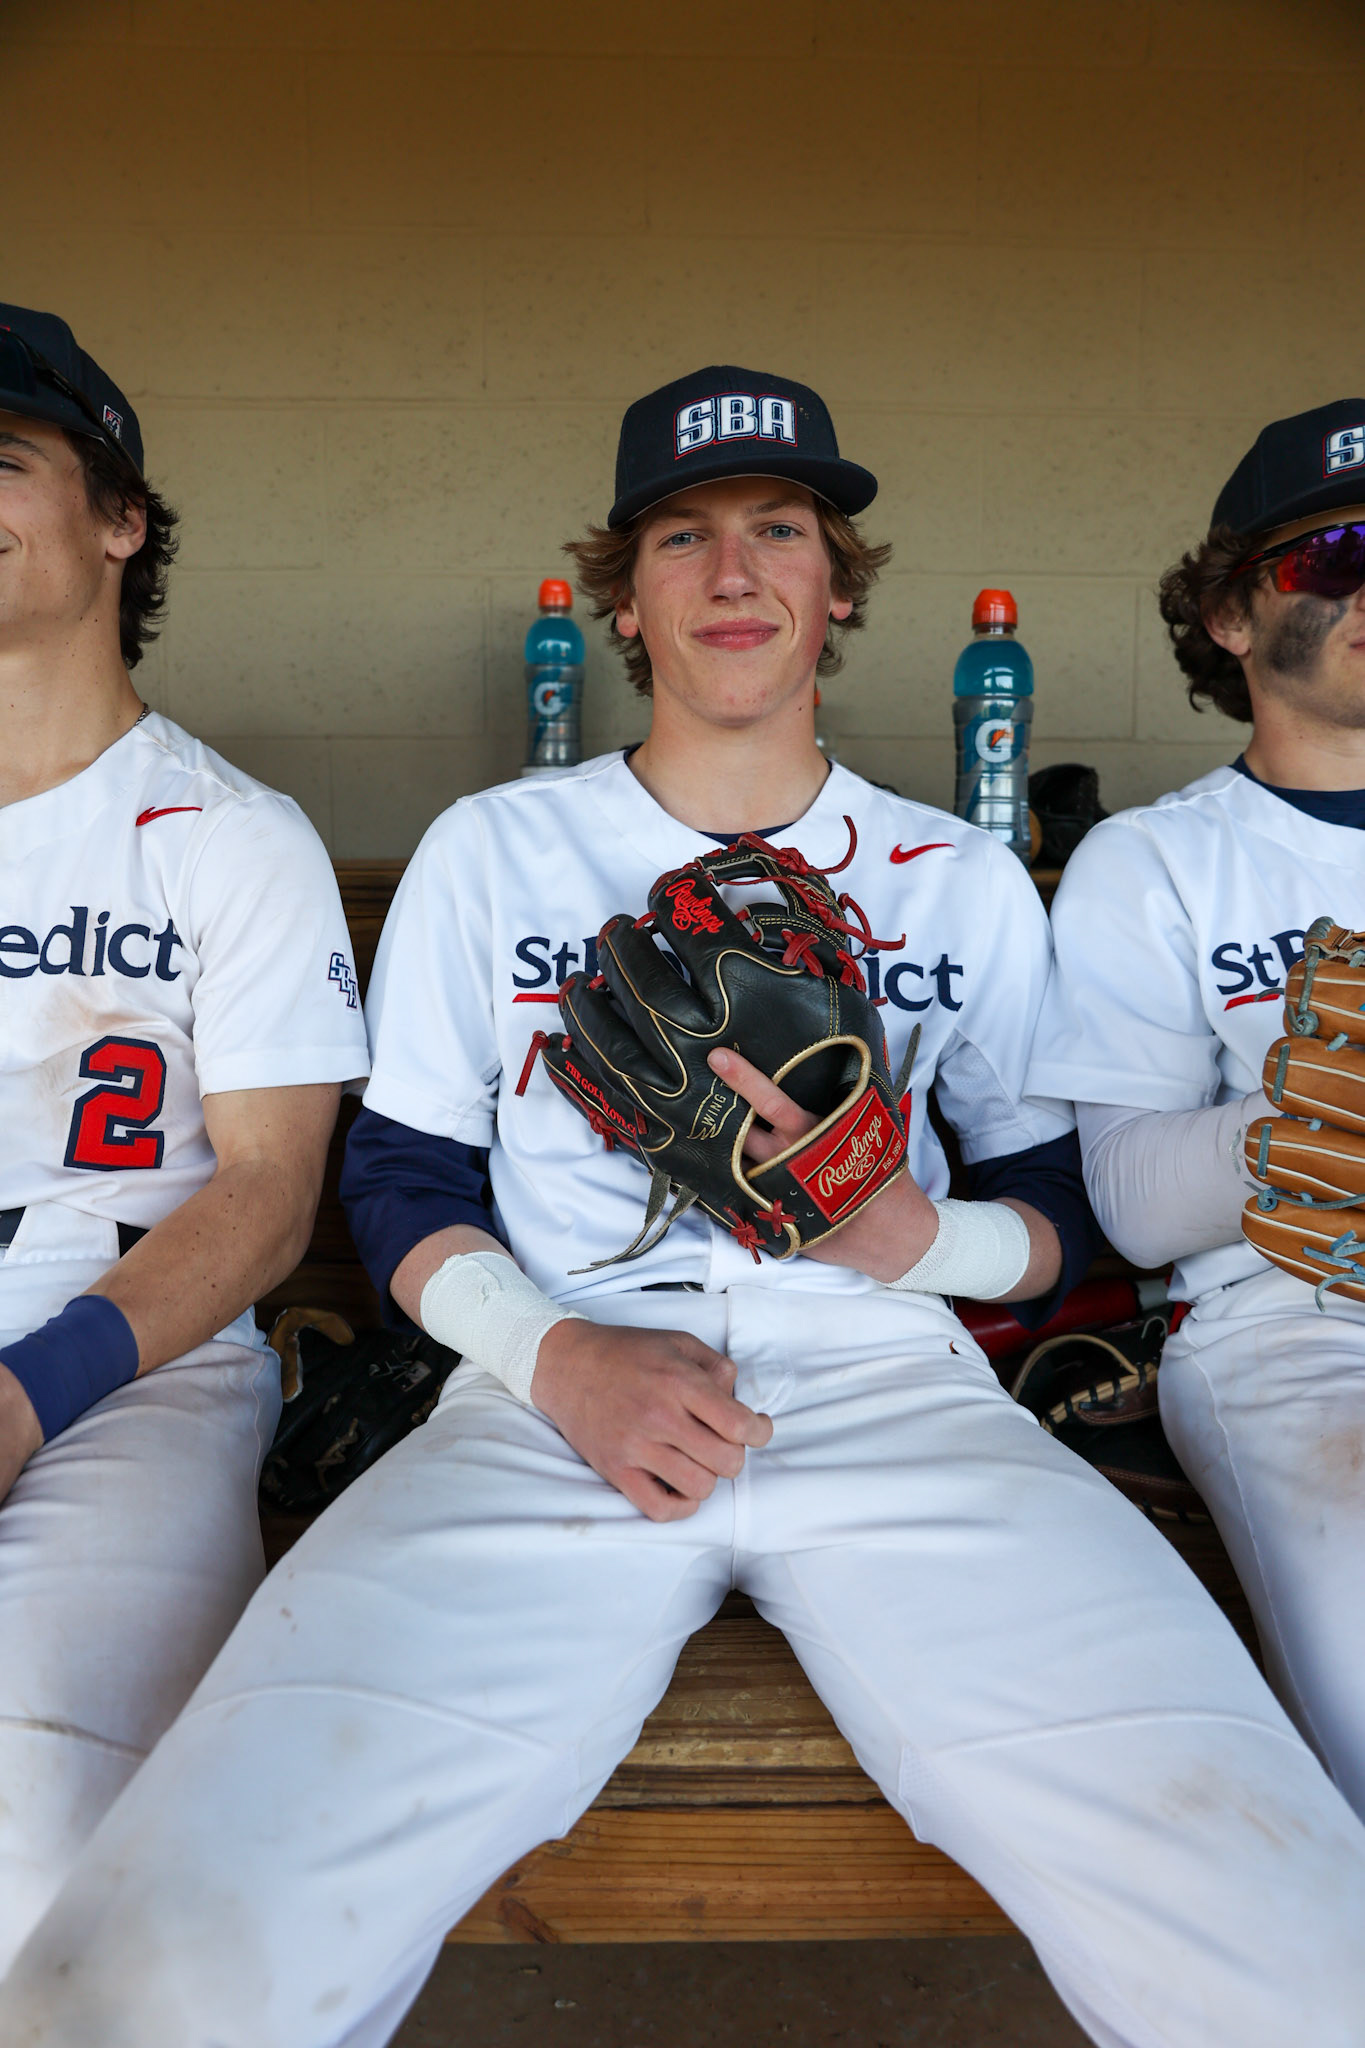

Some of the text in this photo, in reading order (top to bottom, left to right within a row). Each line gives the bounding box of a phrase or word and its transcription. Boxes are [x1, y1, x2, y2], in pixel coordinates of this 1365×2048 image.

[674, 391, 798, 460] SBA
[534, 681, 563, 715] G
[975, 718, 1013, 763] G
[328, 951, 358, 1009] SBA
[848, 935, 964, 1012] ict
[565, 1059, 582, 1084] THE
[63, 1035, 167, 1171] 2
[701, 1093, 727, 1127] WING
[818, 1115, 882, 1198] Rawlings
[882, 1156, 895, 1171] Est.
